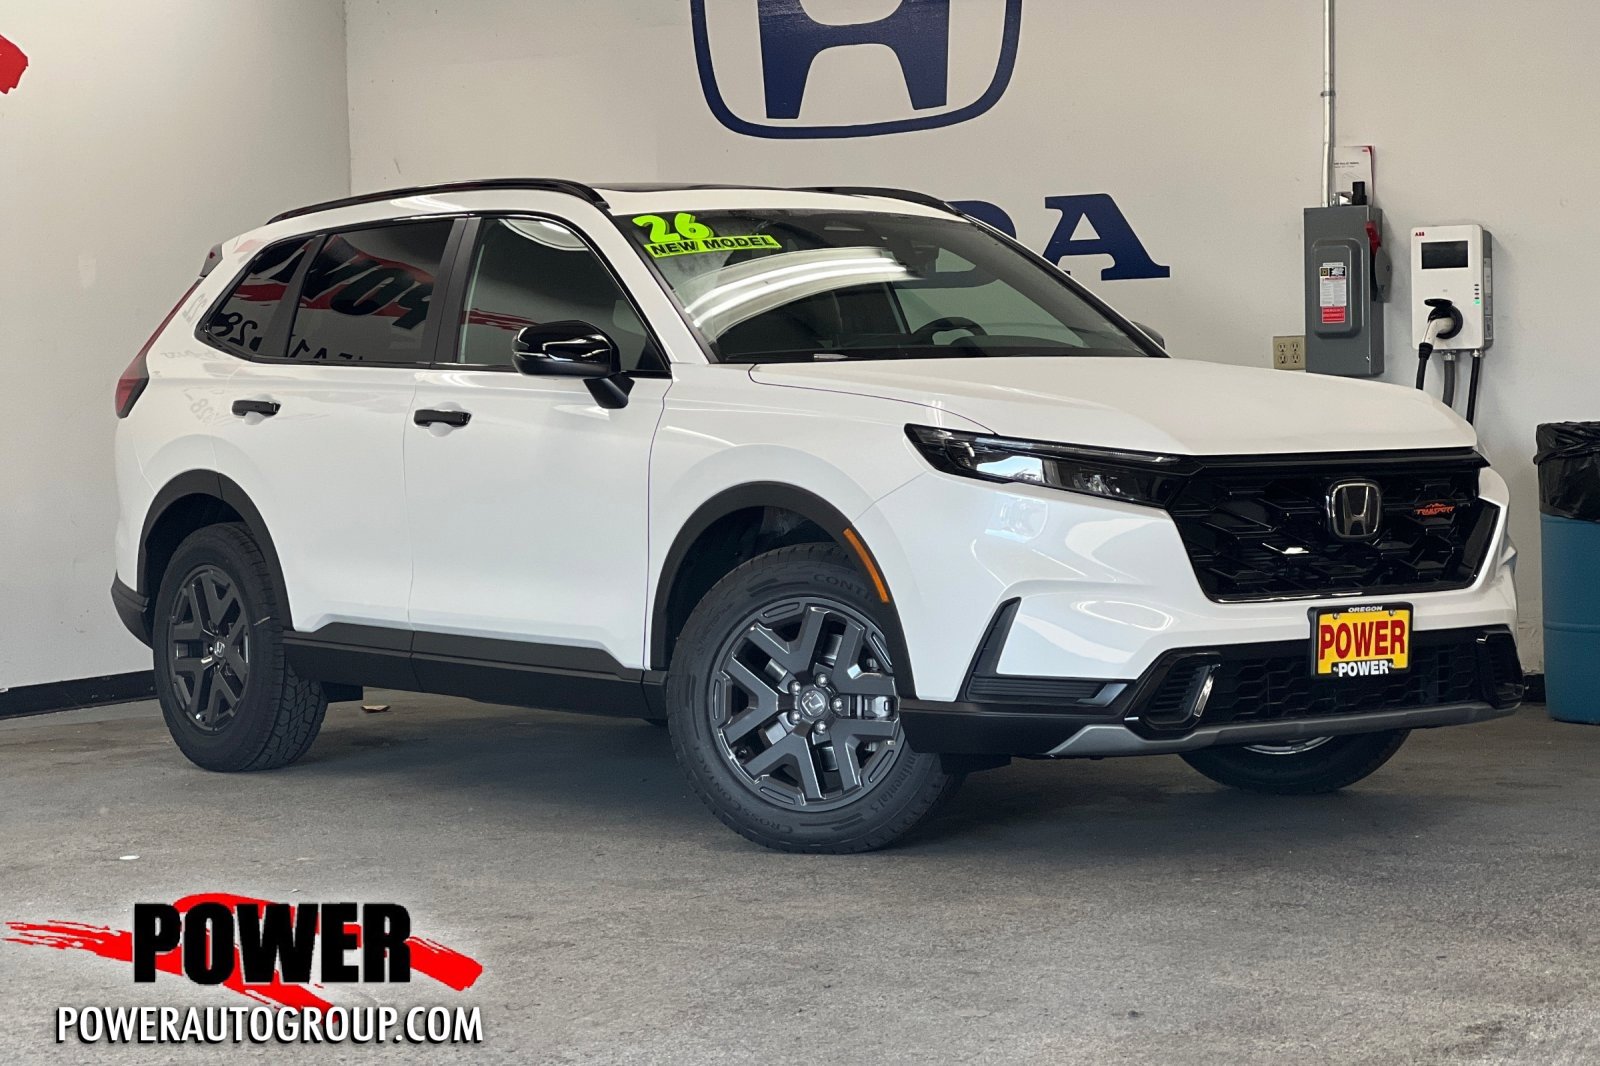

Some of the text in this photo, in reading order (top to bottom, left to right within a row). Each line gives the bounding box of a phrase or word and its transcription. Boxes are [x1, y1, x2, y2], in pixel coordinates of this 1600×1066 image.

[632, 213, 713, 243] 26
[650, 236, 777, 255] NEW MODEL
[1320, 620, 1406, 660] POWER
[1338, 660, 1389, 677] POWER
